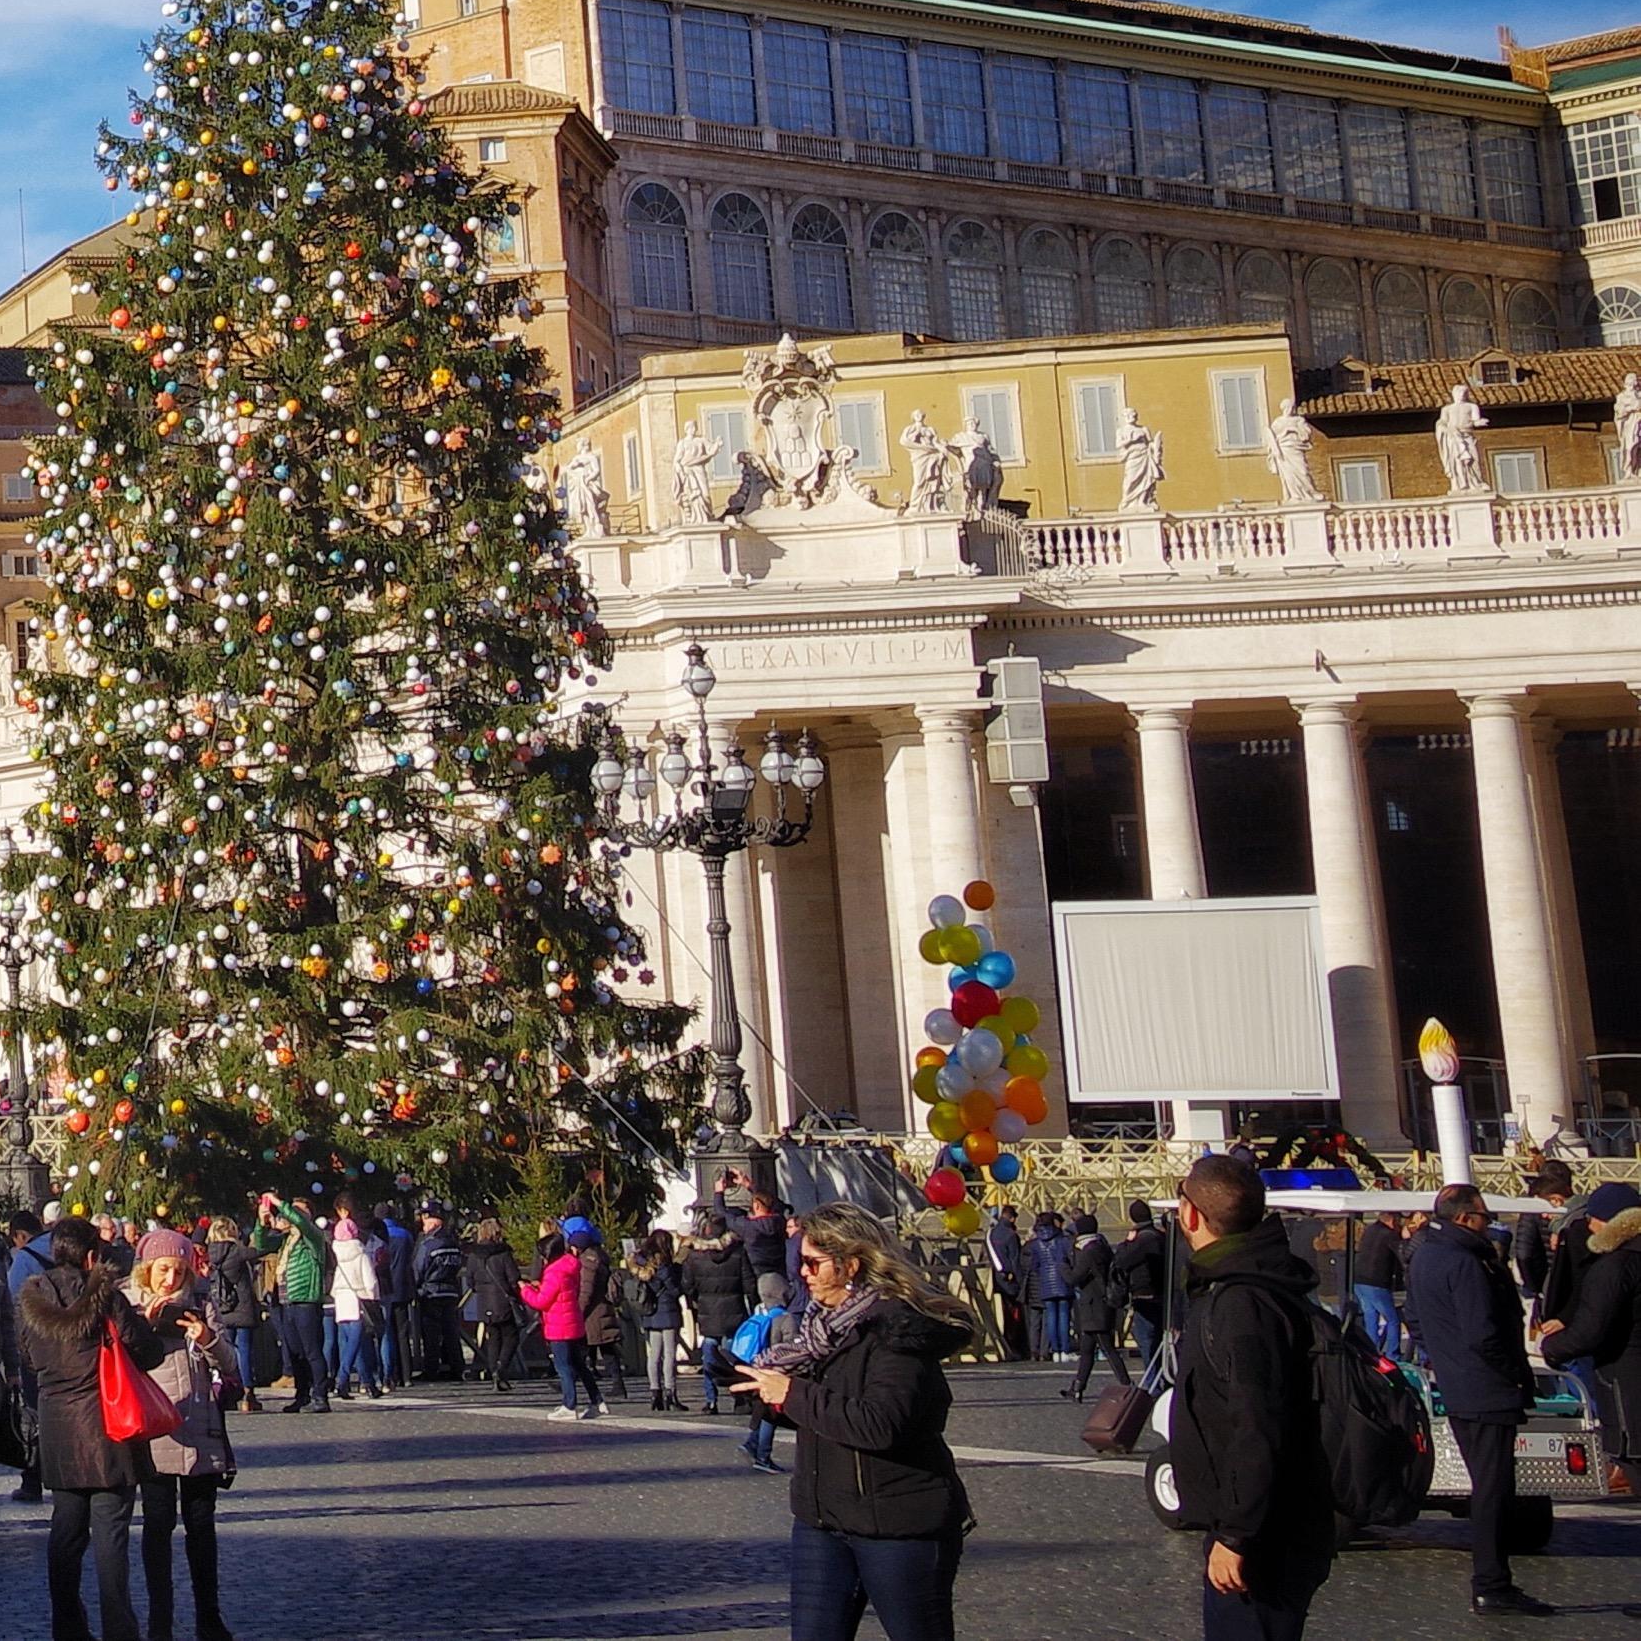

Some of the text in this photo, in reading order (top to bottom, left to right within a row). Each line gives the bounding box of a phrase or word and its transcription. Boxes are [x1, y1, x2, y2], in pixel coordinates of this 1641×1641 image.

[843, 640, 894, 665] VII
[912, 639, 928, 663] P
[942, 636, 968, 660] M
[1548, 1438, 1564, 1453] 87
